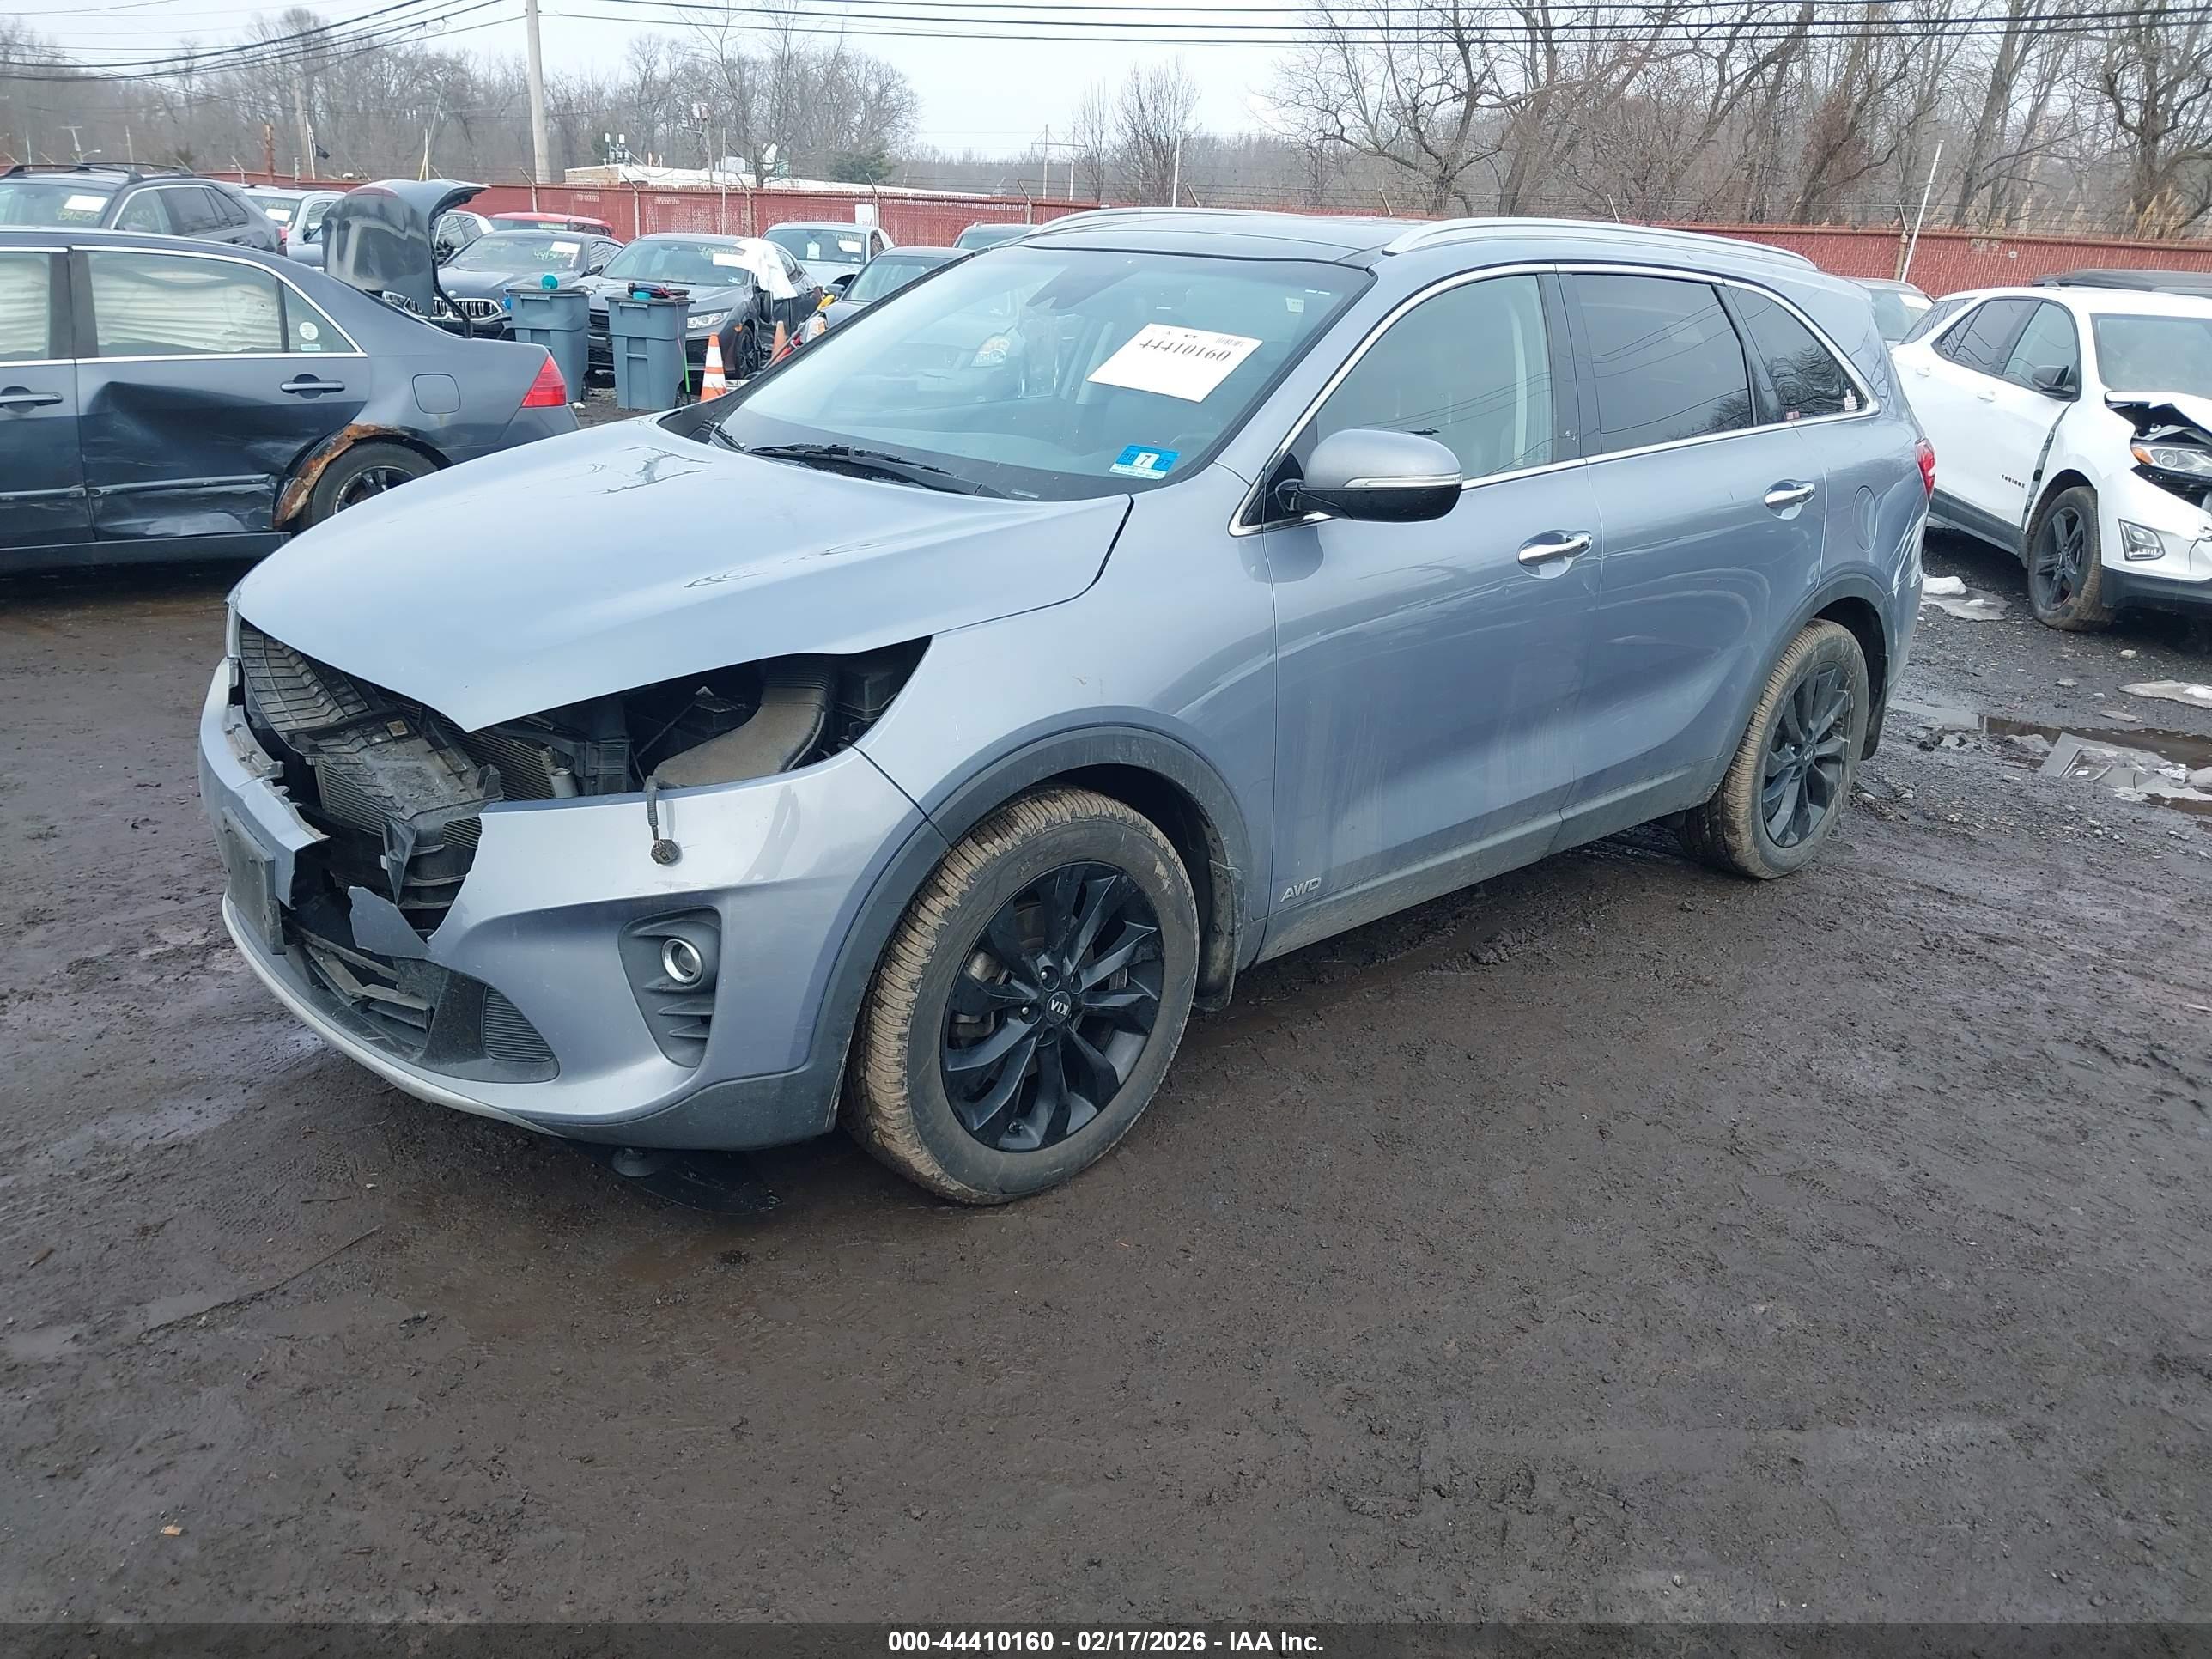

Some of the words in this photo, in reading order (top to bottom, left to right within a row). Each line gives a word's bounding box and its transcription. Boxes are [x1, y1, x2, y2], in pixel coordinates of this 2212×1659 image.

[1139, 338, 1231, 362] 44410160
[1140, 454, 1152, 465] 7
[1279, 876, 1322, 902] AWD
[1050, 999, 1069, 1015] KIA
